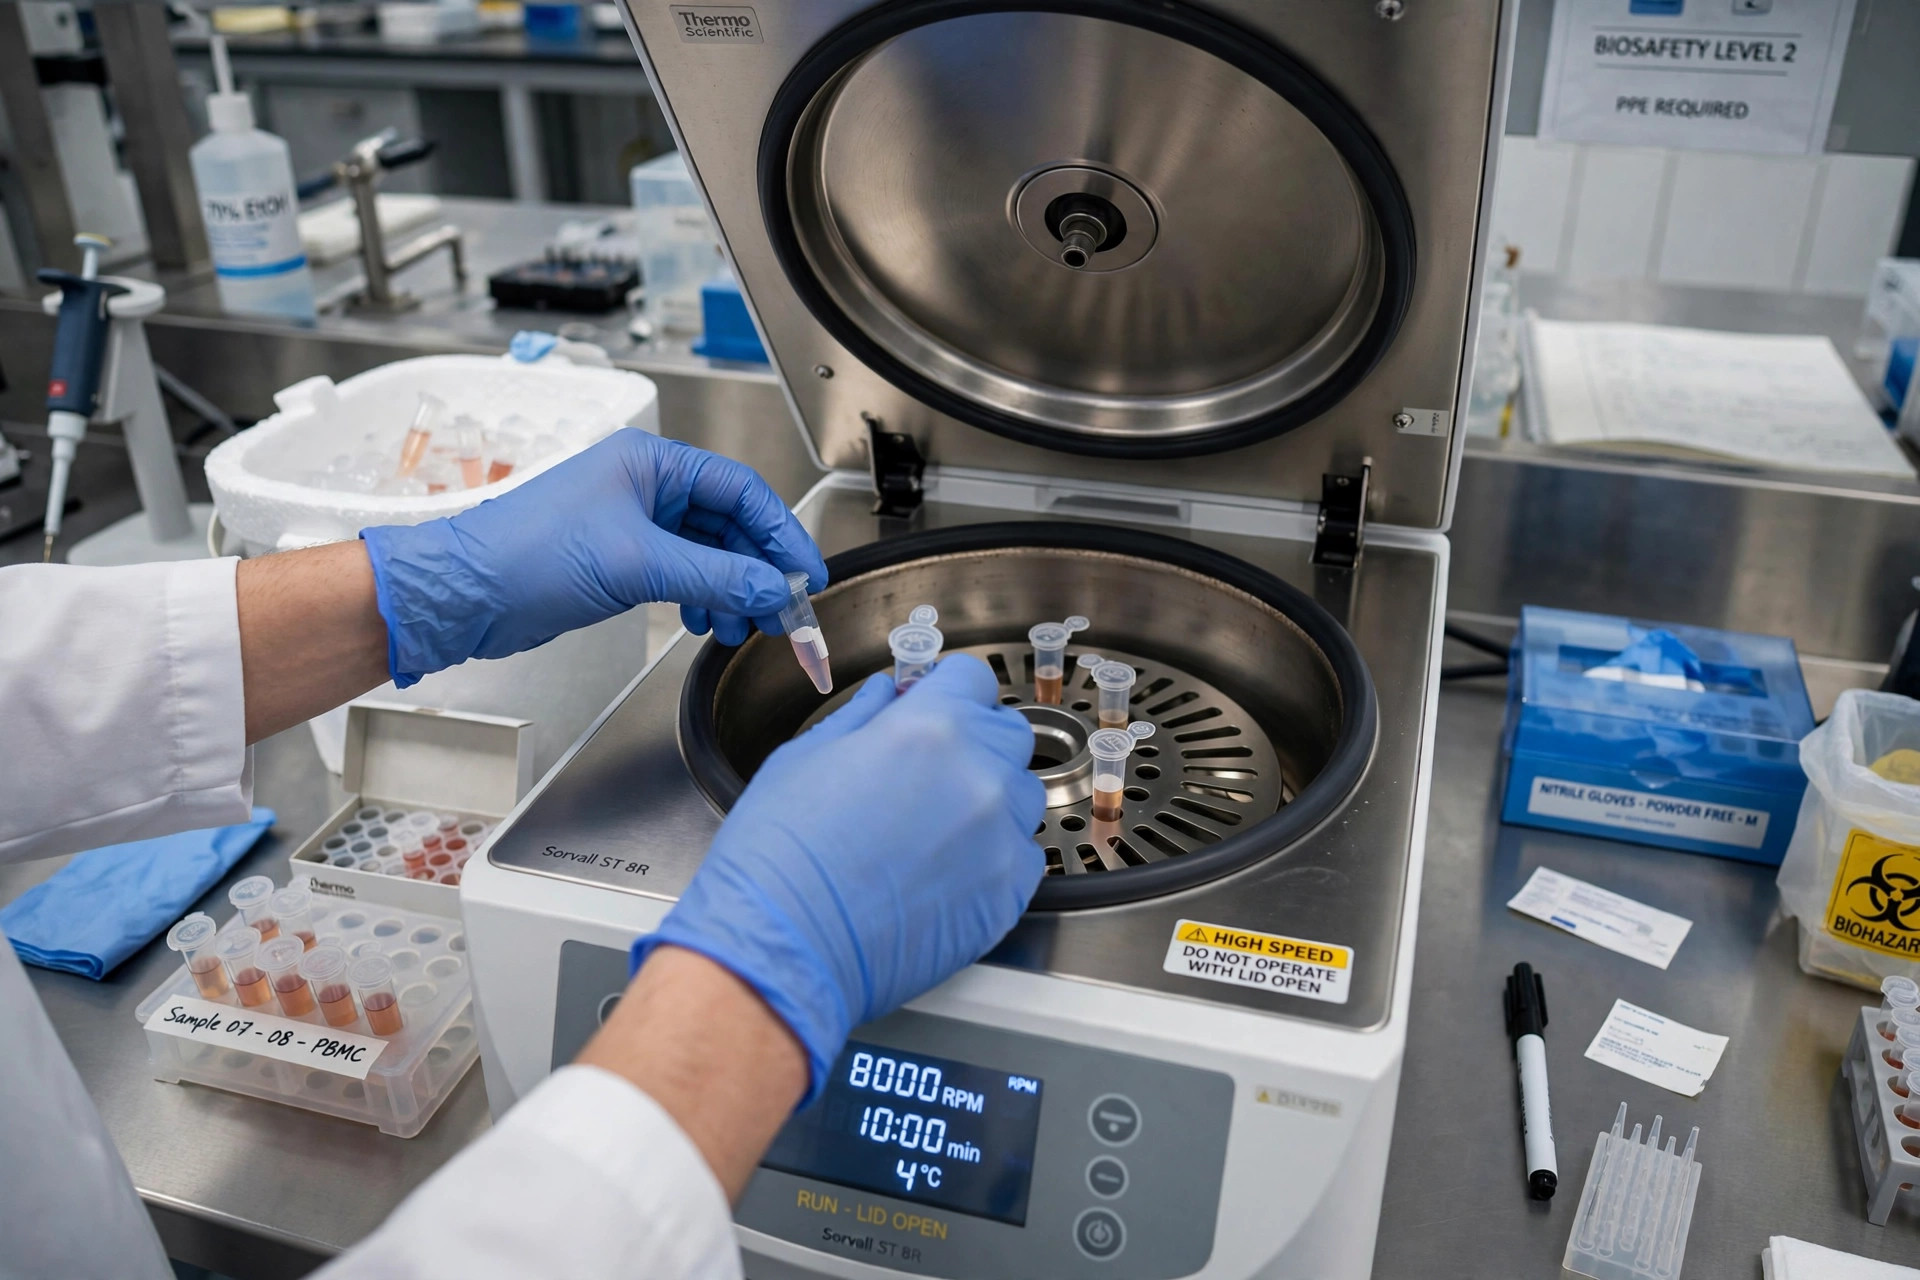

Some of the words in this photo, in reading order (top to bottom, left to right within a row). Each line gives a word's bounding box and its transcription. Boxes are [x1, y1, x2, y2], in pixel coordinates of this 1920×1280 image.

[678, 12, 750, 27] Thermo
[685, 27, 754, 37] Scientific
[1594, 35, 1710, 60] BIOSAFETY
[1714, 40, 1777, 62] LEVEL
[1782, 41, 1798, 63] 2
[1615, 96, 1648, 114] PPE
[1654, 98, 1749, 119] REQUIRED
[1539, 782, 1585, 800] NITRILE
[1587, 790, 1636, 808] GLOVES
[1647, 798, 1701, 818] POWDER
[1704, 806, 1735, 823] FREE
[1745, 814, 1758, 826] M
[542, 846, 599, 864] Sorvall
[599, 856, 625, 870] ST
[625, 862, 650, 875] 8R
[1183, 945, 1209, 959] DO
[1214, 950, 1252, 966] NOT
[1256, 958, 1337, 982] OPERATE
[1214, 931, 1263, 951] HIGH
[1268, 941, 1334, 963] SPEED
[1188, 960, 1233, 978] WITH
[1238, 968, 1266, 984] LID
[1271, 975, 1322, 994] OPEN
[164, 1006, 221, 1033] Sample
[226, 1020, 254, 1036] 07
[267, 1030, 294, 1046] 08
[311, 1038, 366, 1062] PBMC
[849, 1052, 942, 1103] 8000
[941, 1085, 984, 1114] RPM
[1008, 1075, 1038, 1095] RPM
[860, 1106, 947, 1154] 10:00
[946, 1141, 981, 1163] min
[797, 1190, 839, 1214] RUN
[856, 1203, 887, 1226] LID
[892, 1212, 948, 1240] OPEN
[822, 1227, 874, 1251] Sorvall
[877, 1240, 898, 1257] ST
[901, 1246, 922, 1263] 8R
